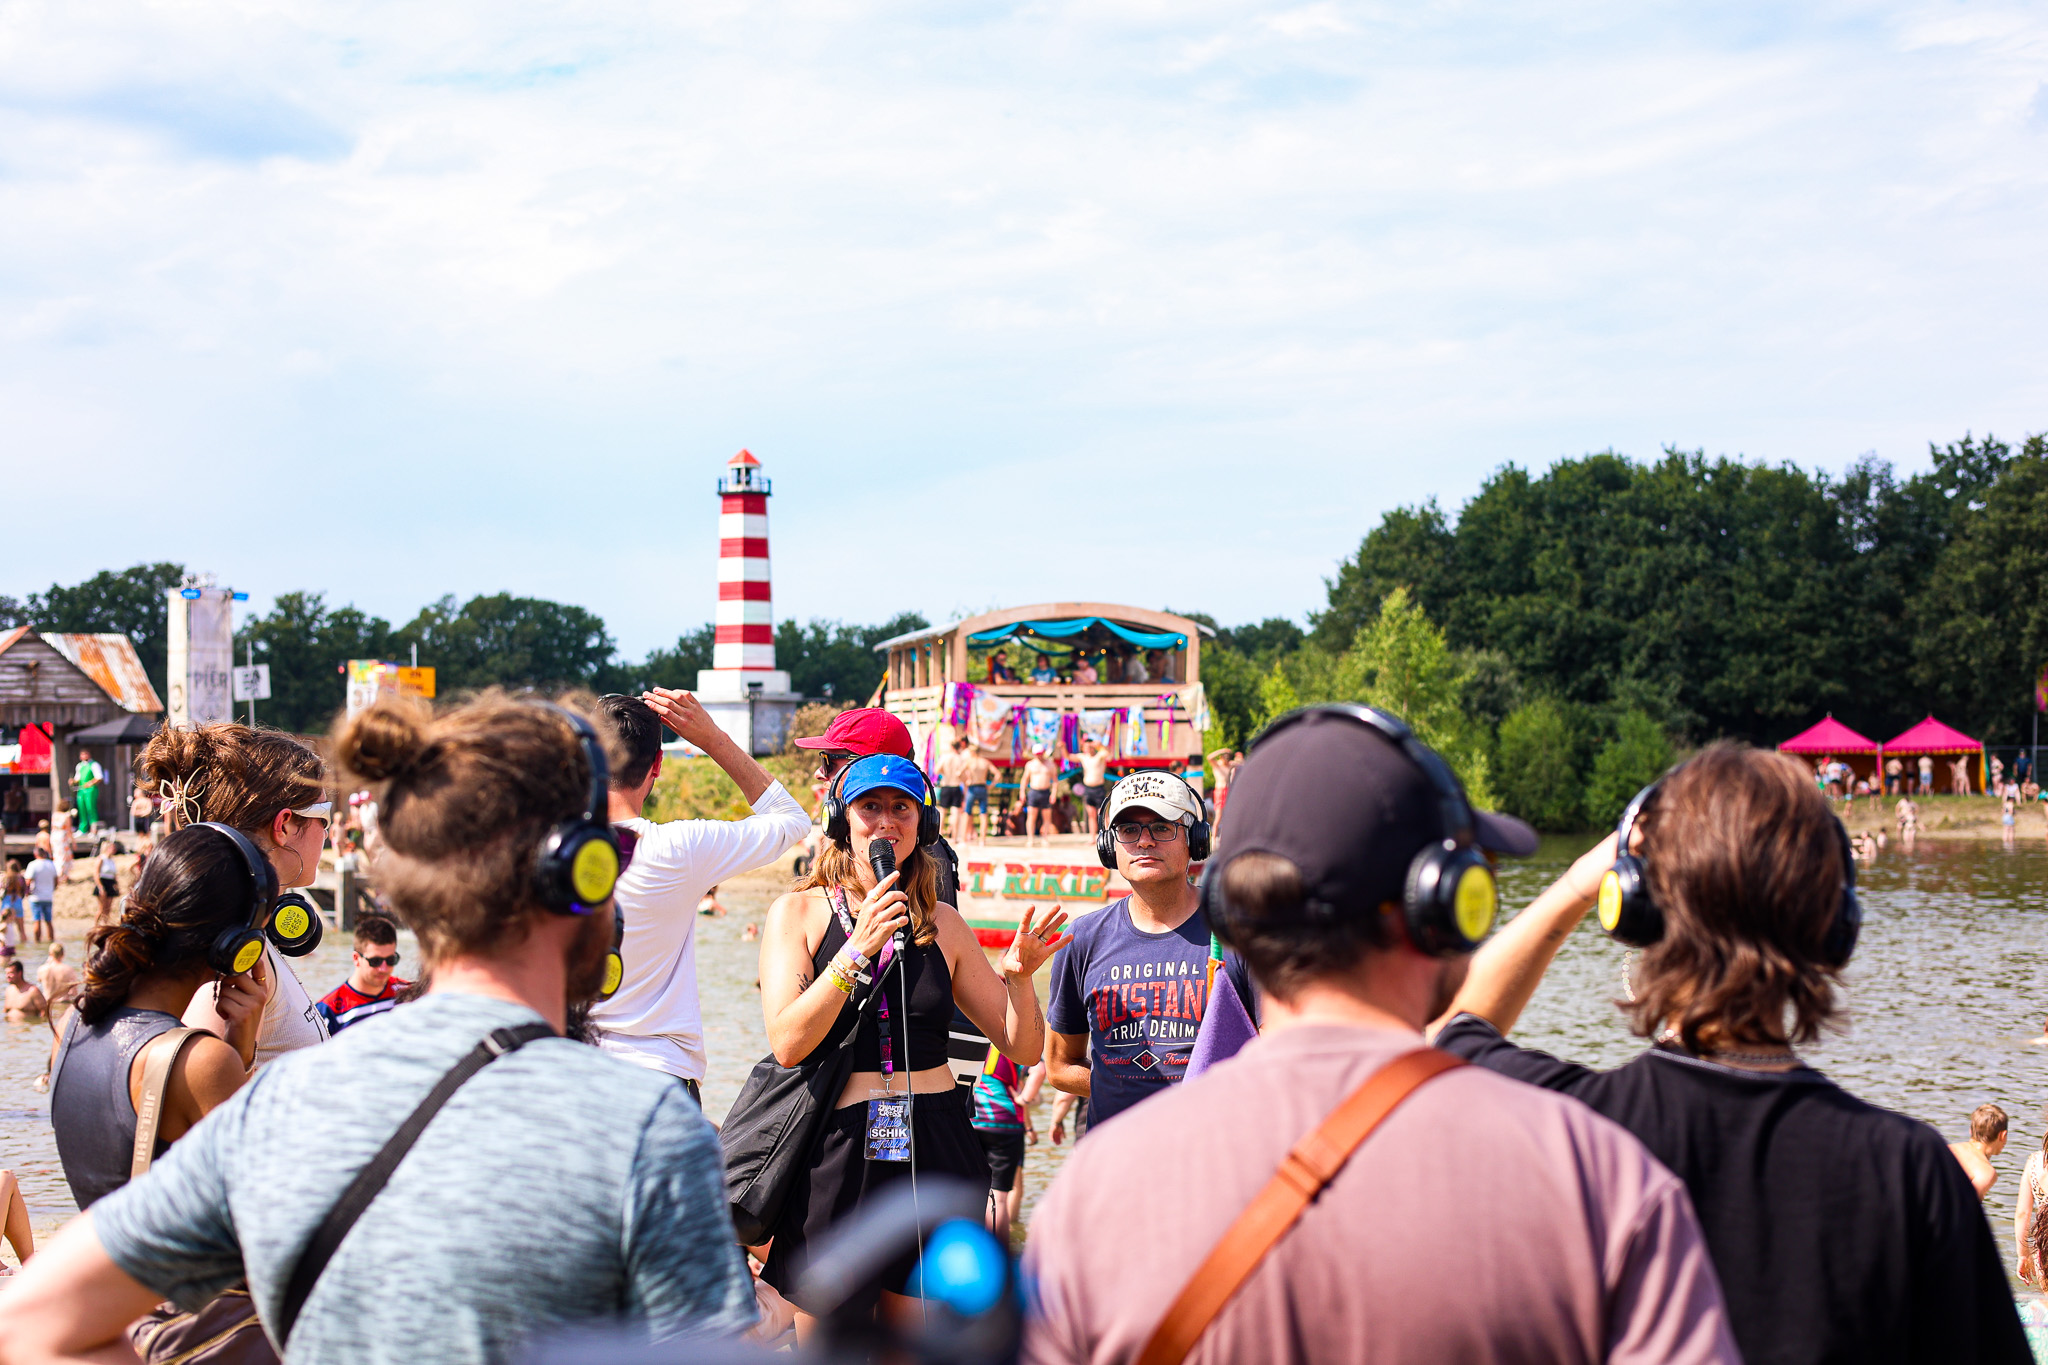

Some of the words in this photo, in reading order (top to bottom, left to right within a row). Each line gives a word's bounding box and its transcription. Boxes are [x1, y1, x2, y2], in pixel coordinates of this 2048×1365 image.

[1133, 782, 1149, 795] M
[1002, 863, 1110, 902] RIKIE
[1111, 960, 1200, 980] ORIGINAL
[1091, 979, 1205, 1032] MUSTAN
[1112, 1020, 1144, 1040] TRUE
[1150, 1019, 1195, 1038] DENIM
[872, 1128, 907, 1138] SCHIK
